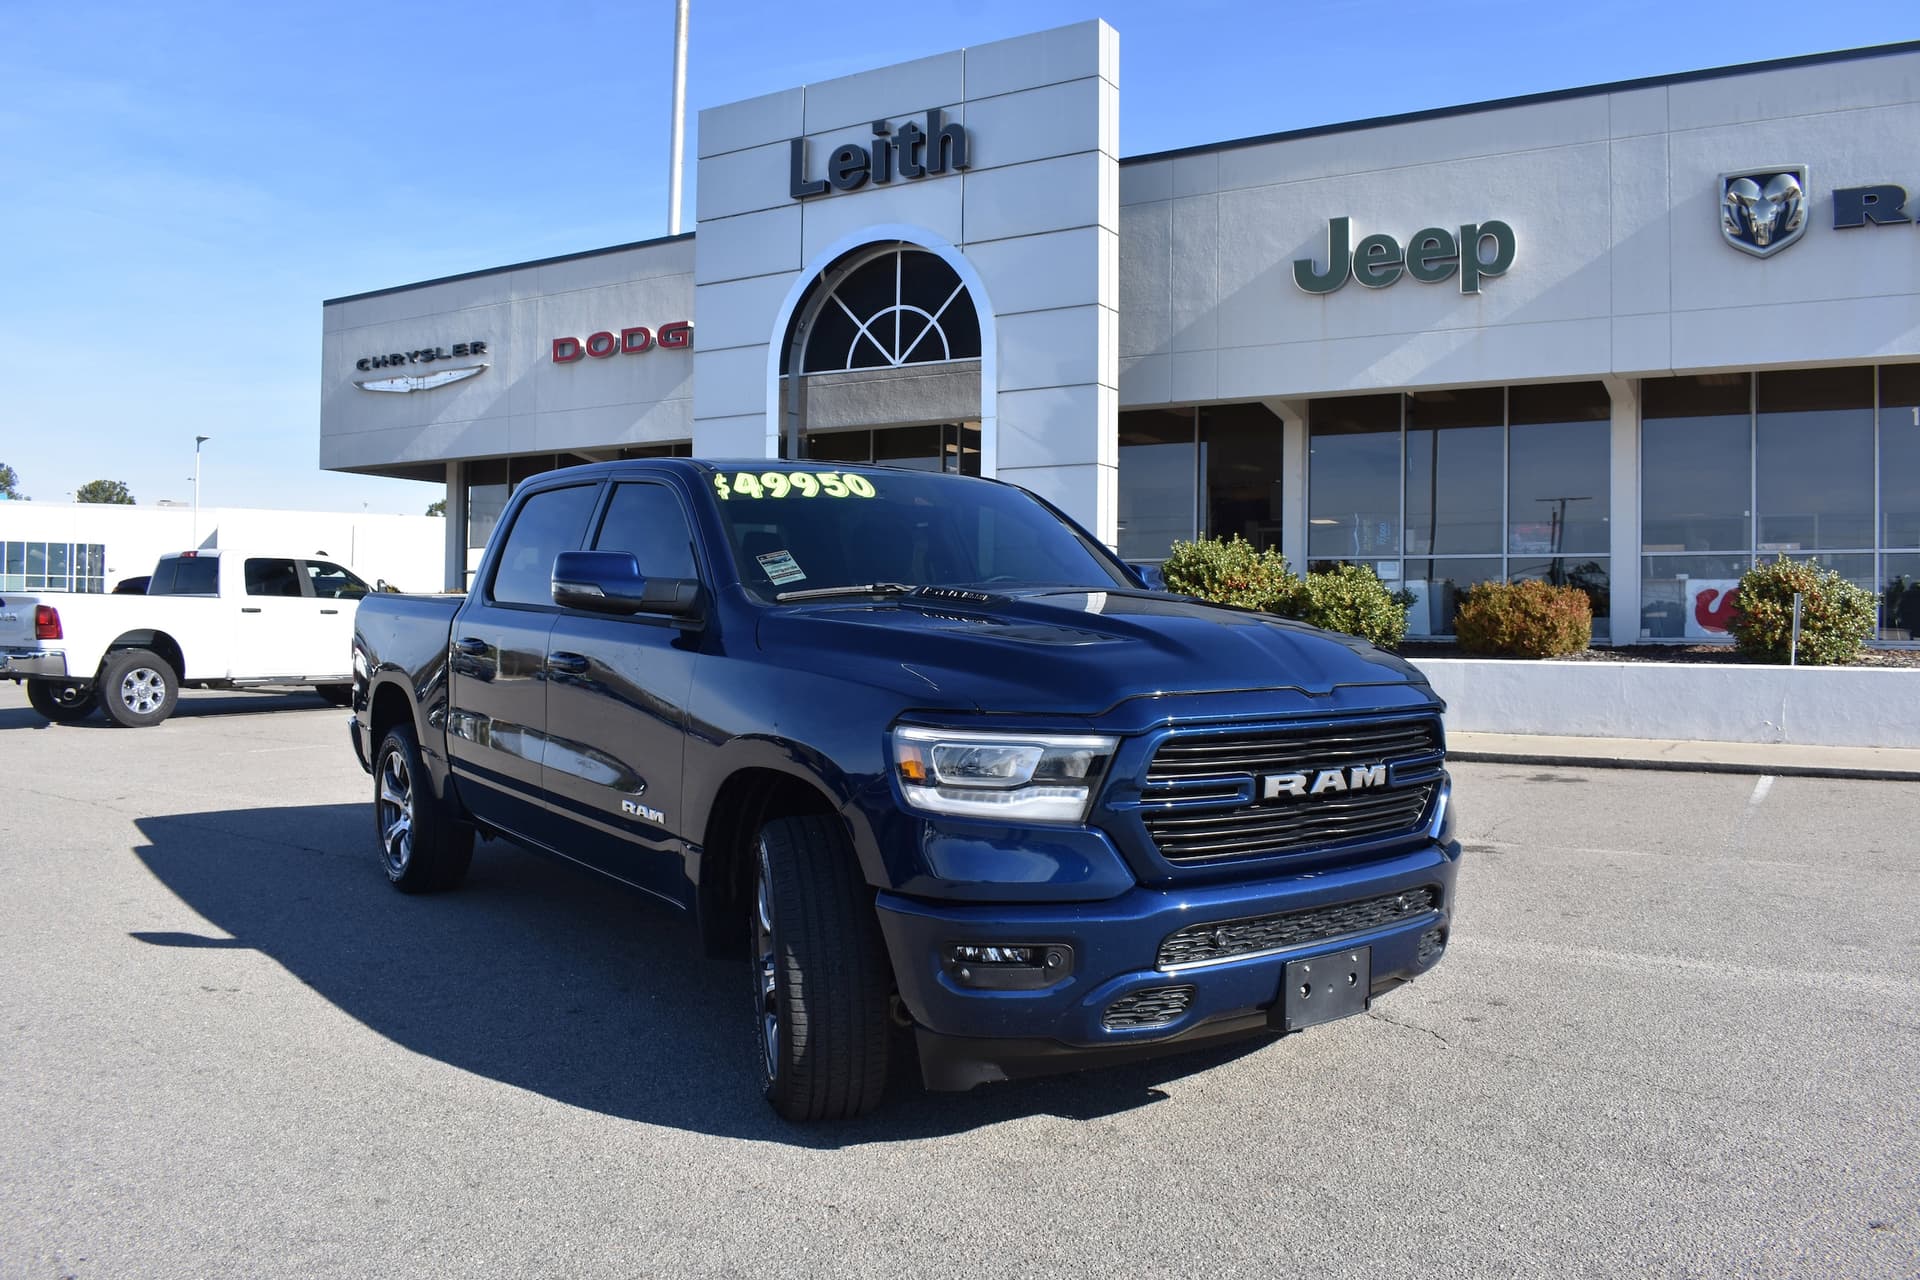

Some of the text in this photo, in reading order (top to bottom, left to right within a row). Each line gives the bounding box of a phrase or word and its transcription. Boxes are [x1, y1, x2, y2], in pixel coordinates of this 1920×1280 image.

[790, 109, 969, 199] Leith
[1832, 185, 1920, 230] R
[1293, 216, 1517, 295] Jeep
[356, 341, 487, 371] CHRYSLER
[552, 320, 695, 363] DODG
[714, 472, 876, 500] $49950
[1264, 764, 1386, 799] RAM
[621, 799, 665, 825] RAM
